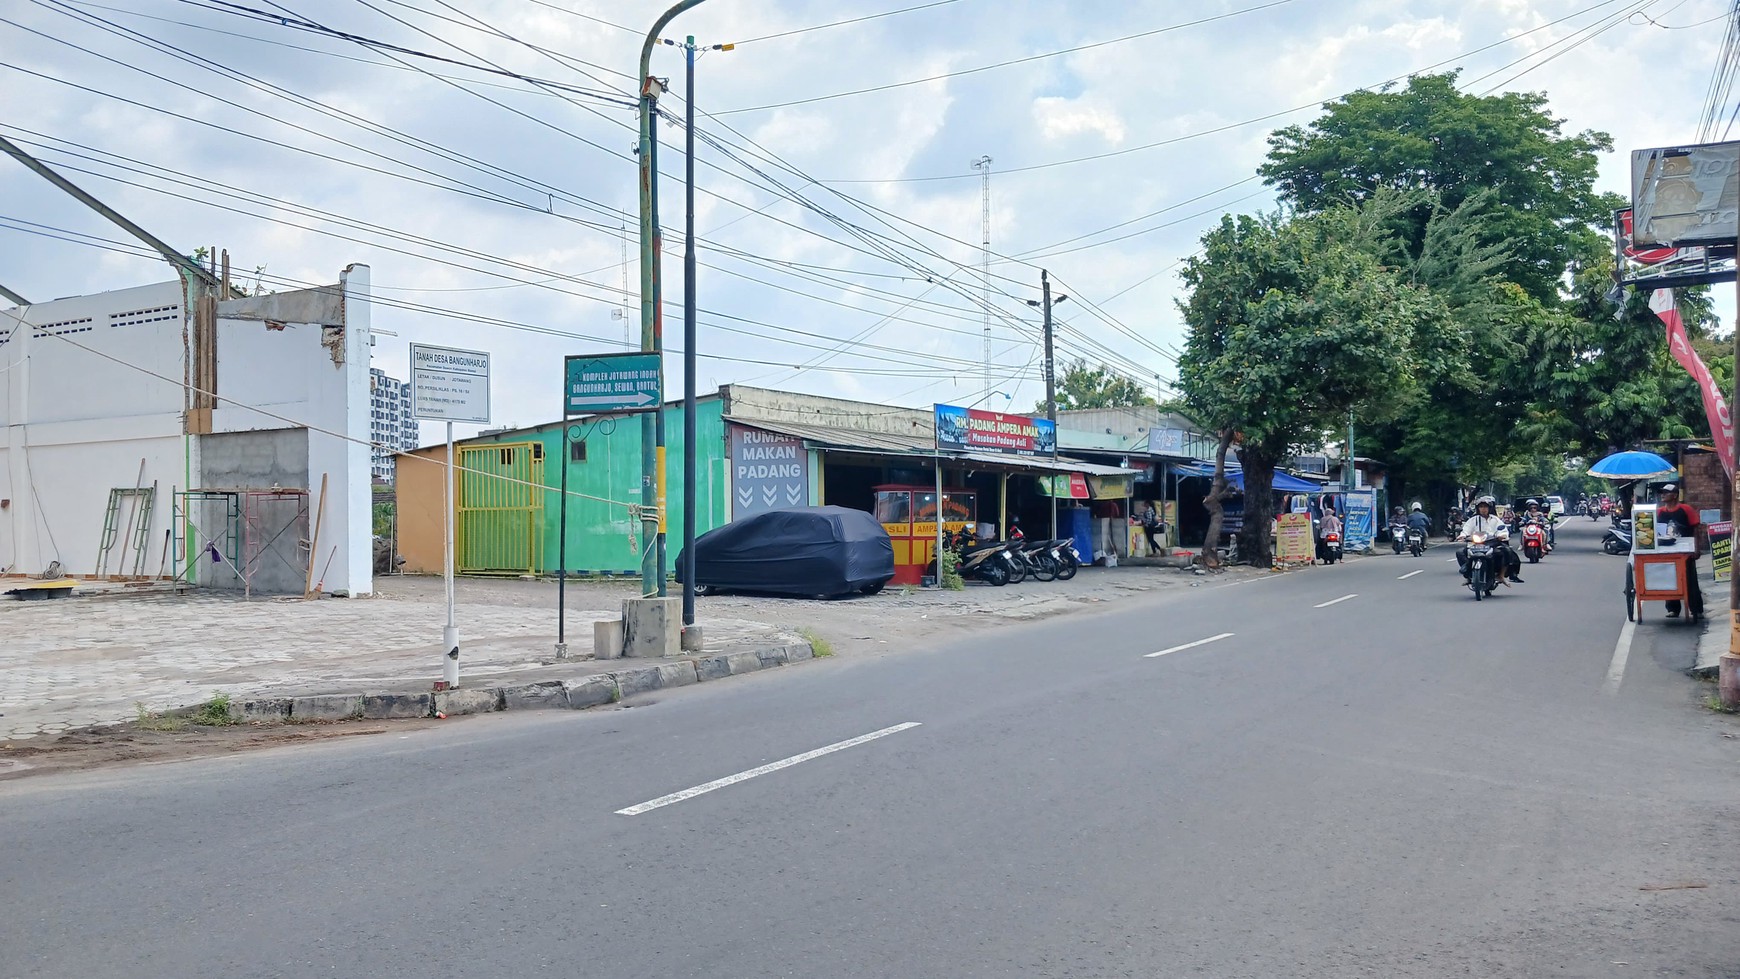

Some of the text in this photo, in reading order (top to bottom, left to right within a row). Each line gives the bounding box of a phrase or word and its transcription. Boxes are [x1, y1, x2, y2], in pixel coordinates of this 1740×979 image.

[416, 352, 486, 368] TANAH DESA BANGUNHARJO
[640, 370, 656, 378] INDAH
[970, 418, 995, 432] PADANG
[997, 422, 1020, 435] AMPERA
[1023, 425, 1039, 437] AMAK
[972, 433, 996, 443] Masakan
[997, 436, 1015, 448] Padang
[1016, 437, 1026, 447] Asli
[743, 446, 796, 460] MAKAN
[738, 464, 800, 479] PADANG
[1712, 538, 1730, 548] GANTI
